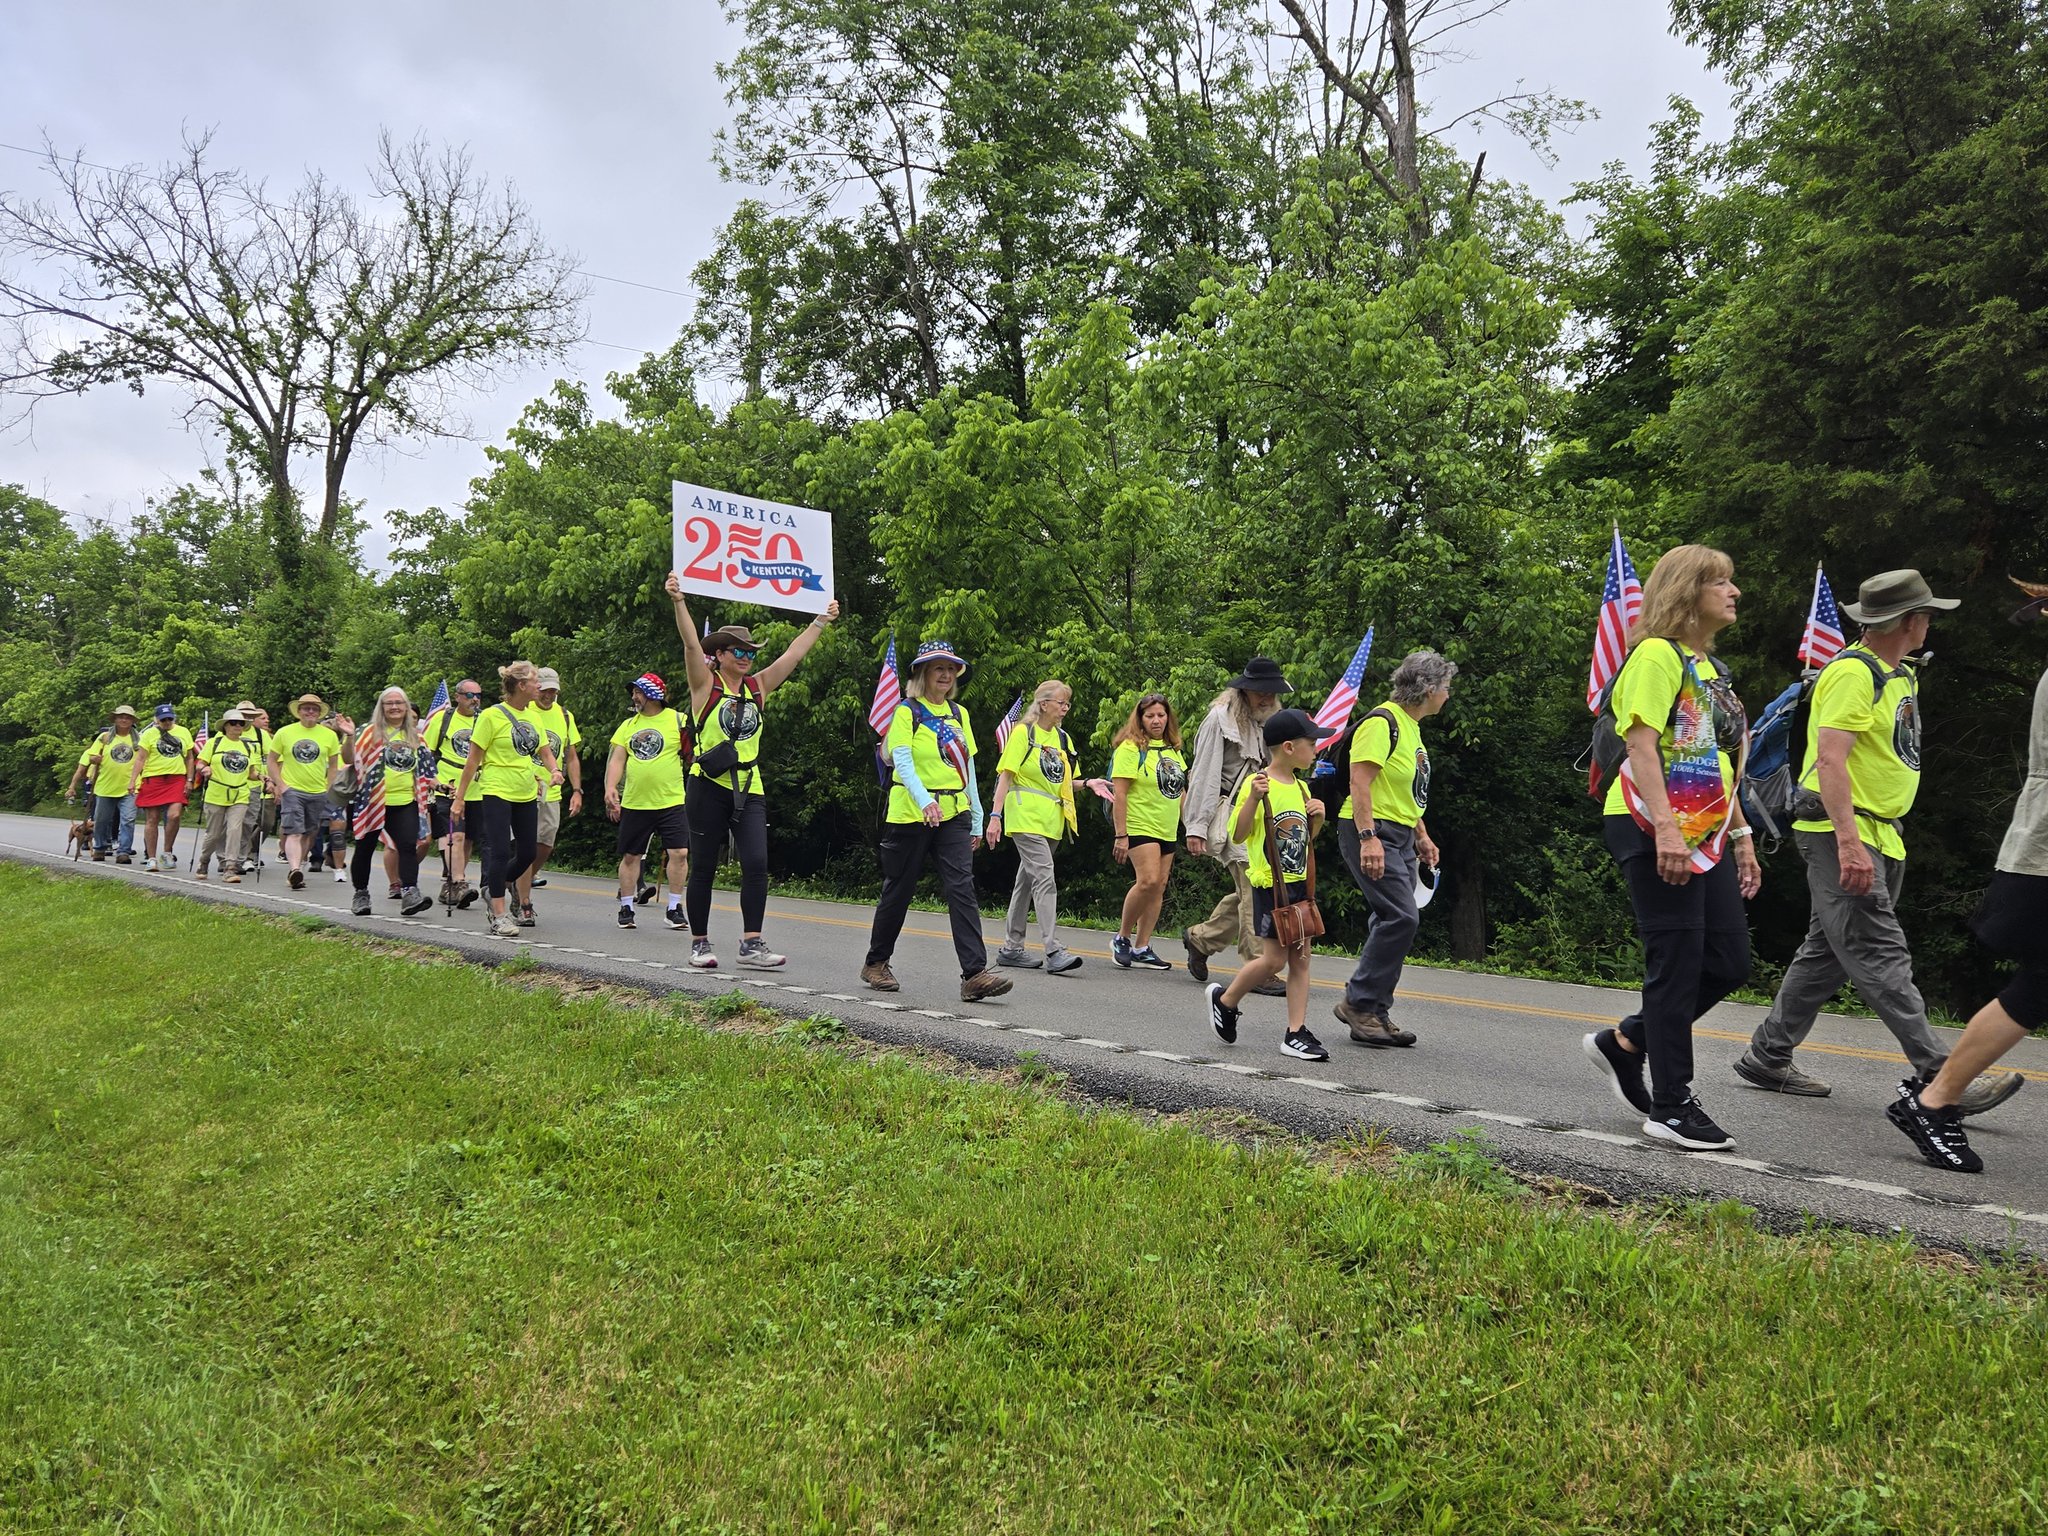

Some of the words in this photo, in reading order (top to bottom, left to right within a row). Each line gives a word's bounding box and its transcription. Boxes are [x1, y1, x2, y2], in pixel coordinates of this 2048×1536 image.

[691, 495, 797, 528] AMERICA
[683, 516, 803, 596] 250
[752, 565, 805, 577] KENTUCKY
[1679, 753, 1718, 768] LODGE
